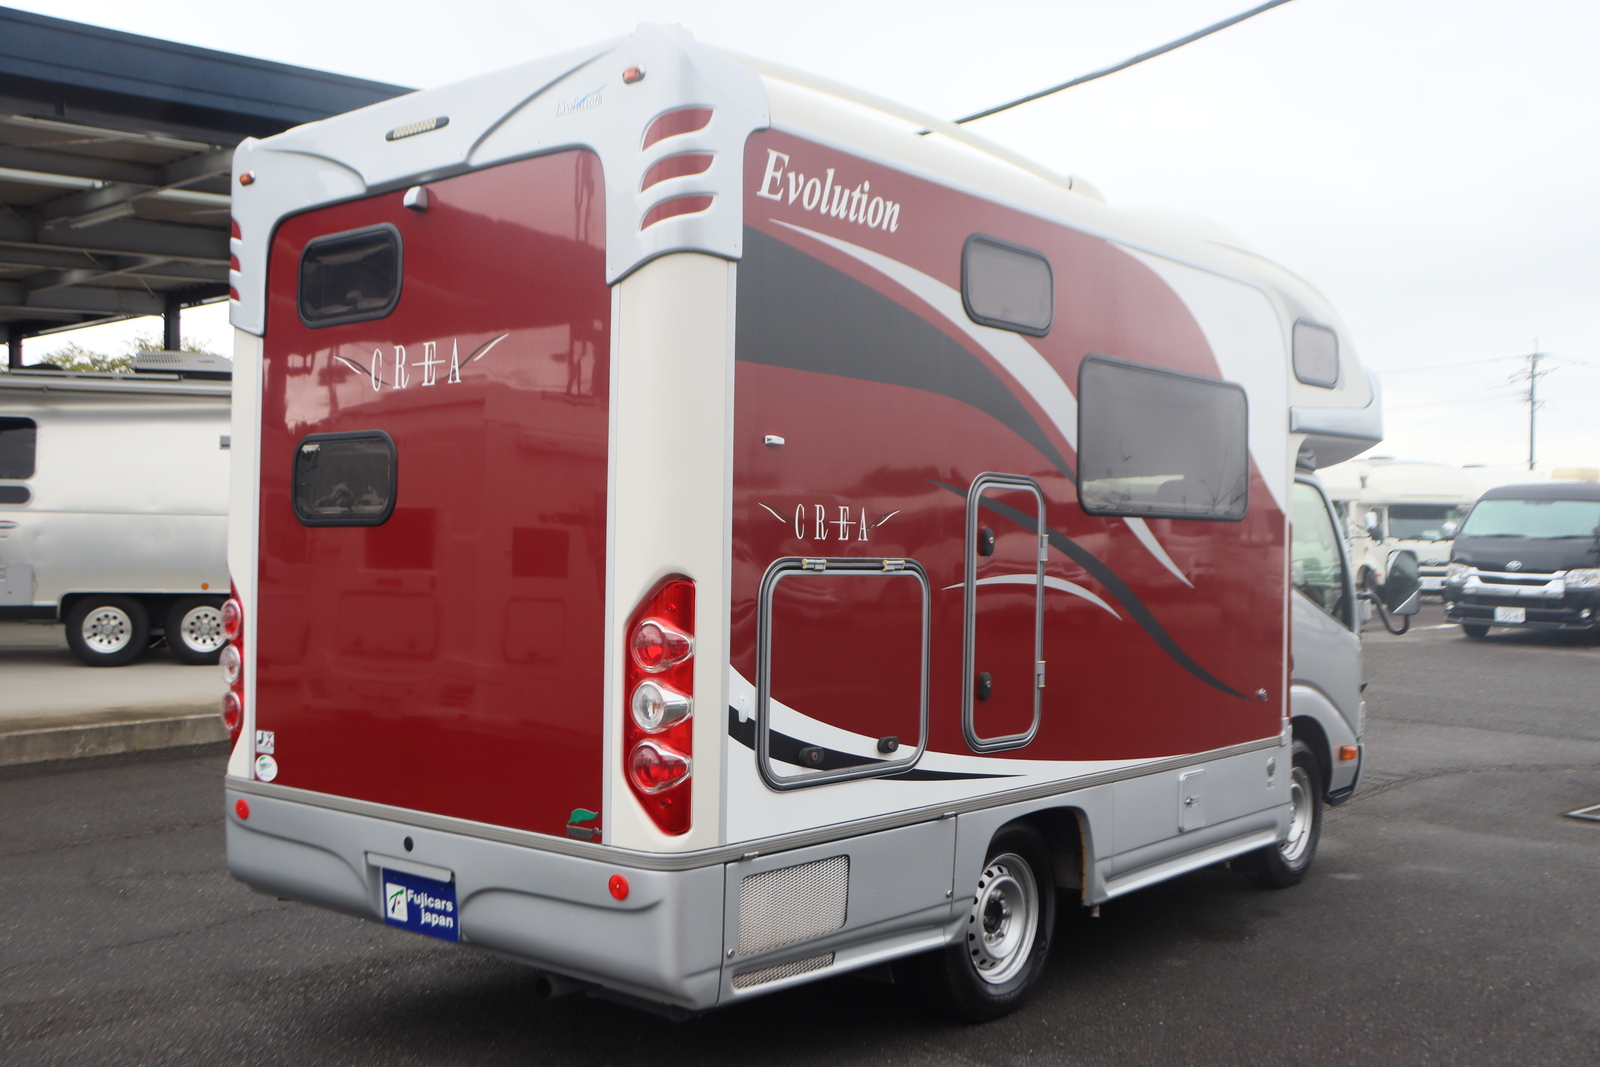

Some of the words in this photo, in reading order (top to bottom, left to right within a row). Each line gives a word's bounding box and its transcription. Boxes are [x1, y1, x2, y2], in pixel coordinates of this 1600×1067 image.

[756, 148, 901, 233] Evolution
[371, 337, 462, 392] CREA
[795, 503, 869, 541] CREA
[407, 888, 454, 913] Fujicars
